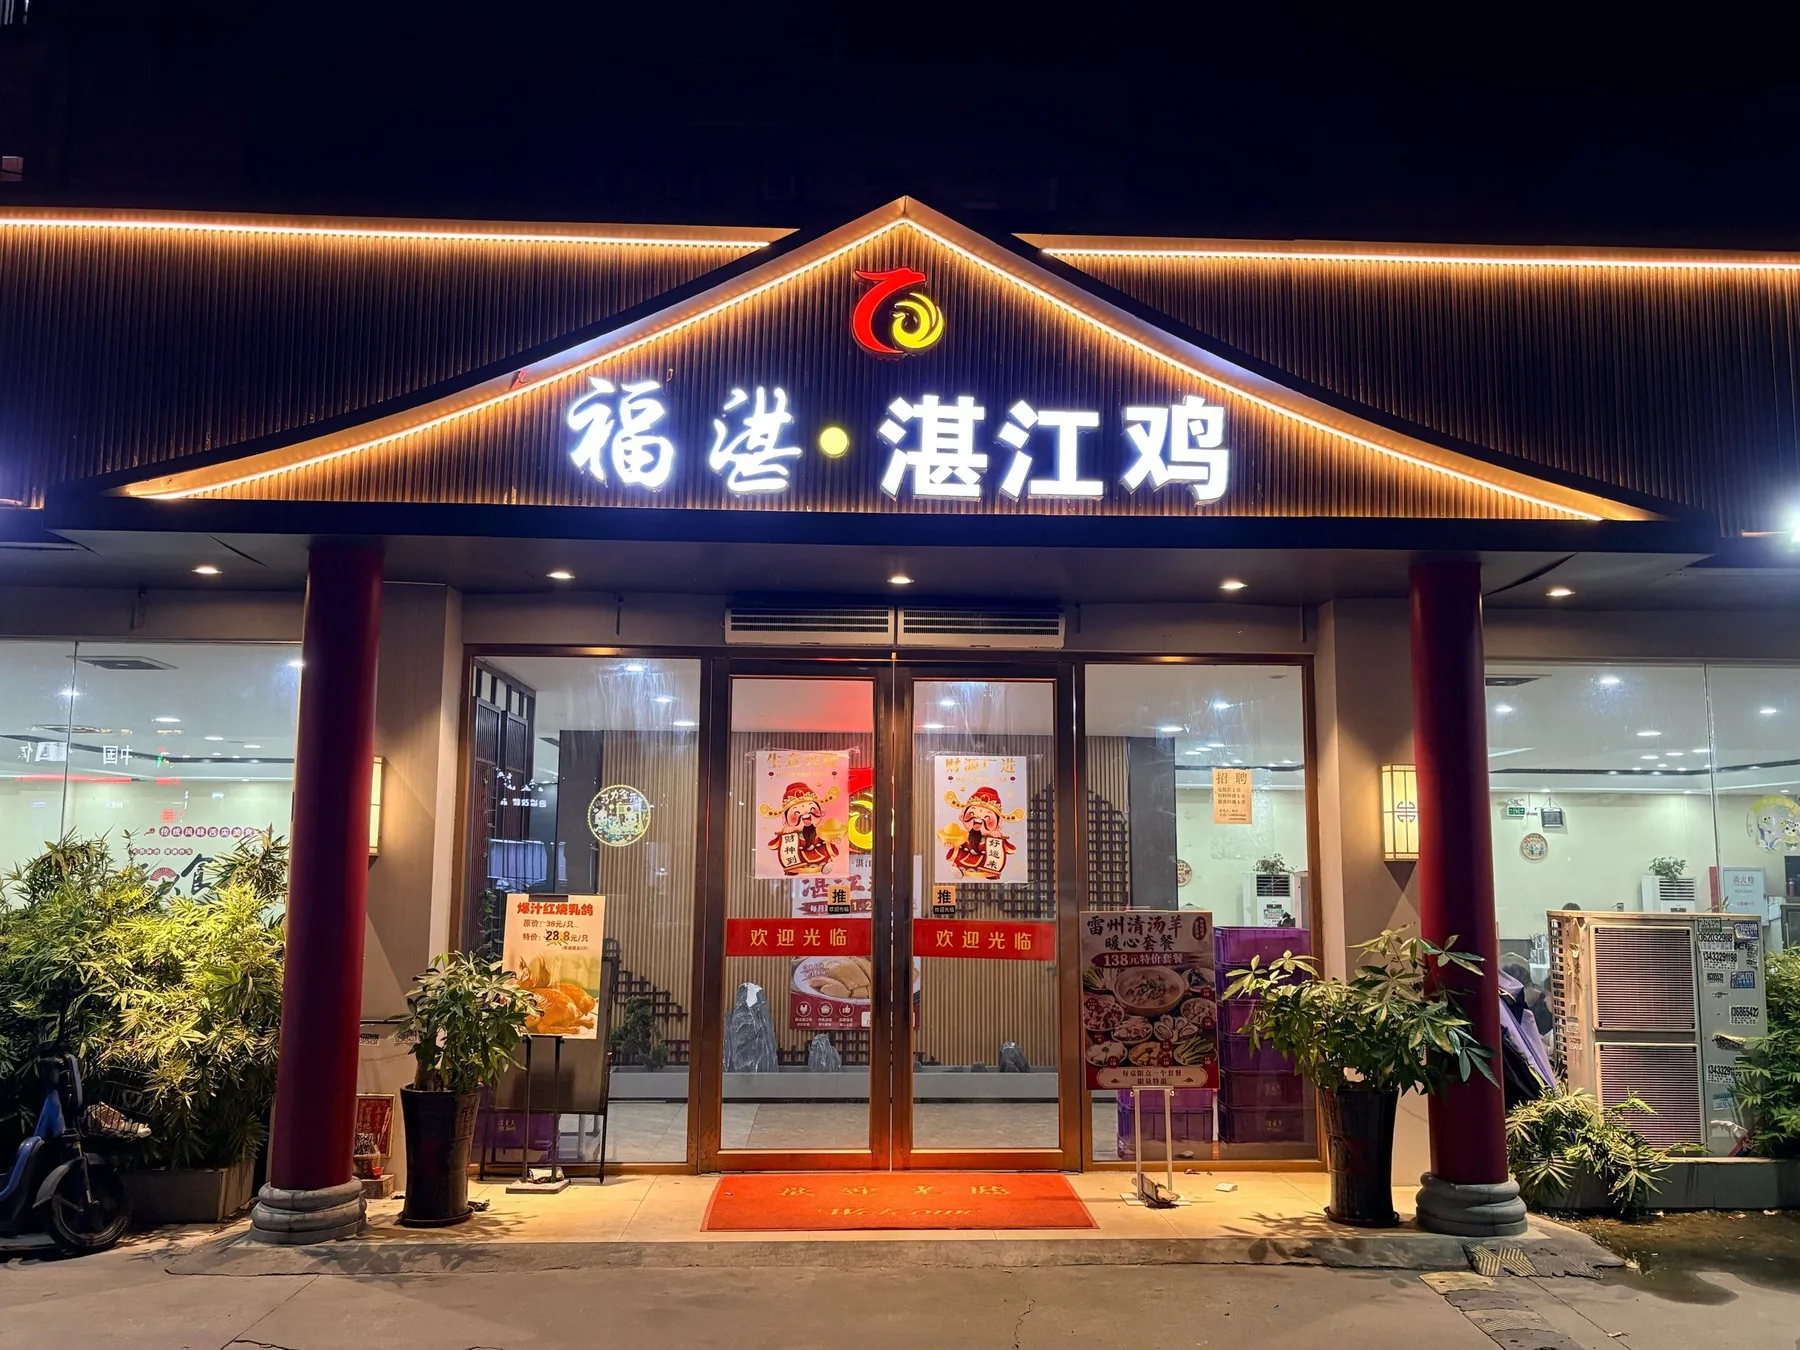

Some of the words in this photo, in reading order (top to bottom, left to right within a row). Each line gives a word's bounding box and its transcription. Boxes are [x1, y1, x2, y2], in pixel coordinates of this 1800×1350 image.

[945, 757, 1016, 773] 财源广进
[1216, 772, 1248, 785] 招聘
[784, 834, 798, 864] 财神到
[986, 838, 1001, 870] 好运来
[1732, 875, 1755, 884] 消火栓
[832, 889, 847, 903] 推
[937, 889, 952, 904] 推
[517, 902, 594, 917] 爆汁红烧乳鸽
[1087, 915, 1183, 938] 雷州清汤羊
[750, 928, 848, 947] 欢迎光临
[935, 929, 1032, 950] 欢迎光临
[1105, 935, 1176, 951] 暖心套餐
[1104, 953, 1183, 967] 138元特价套餐
